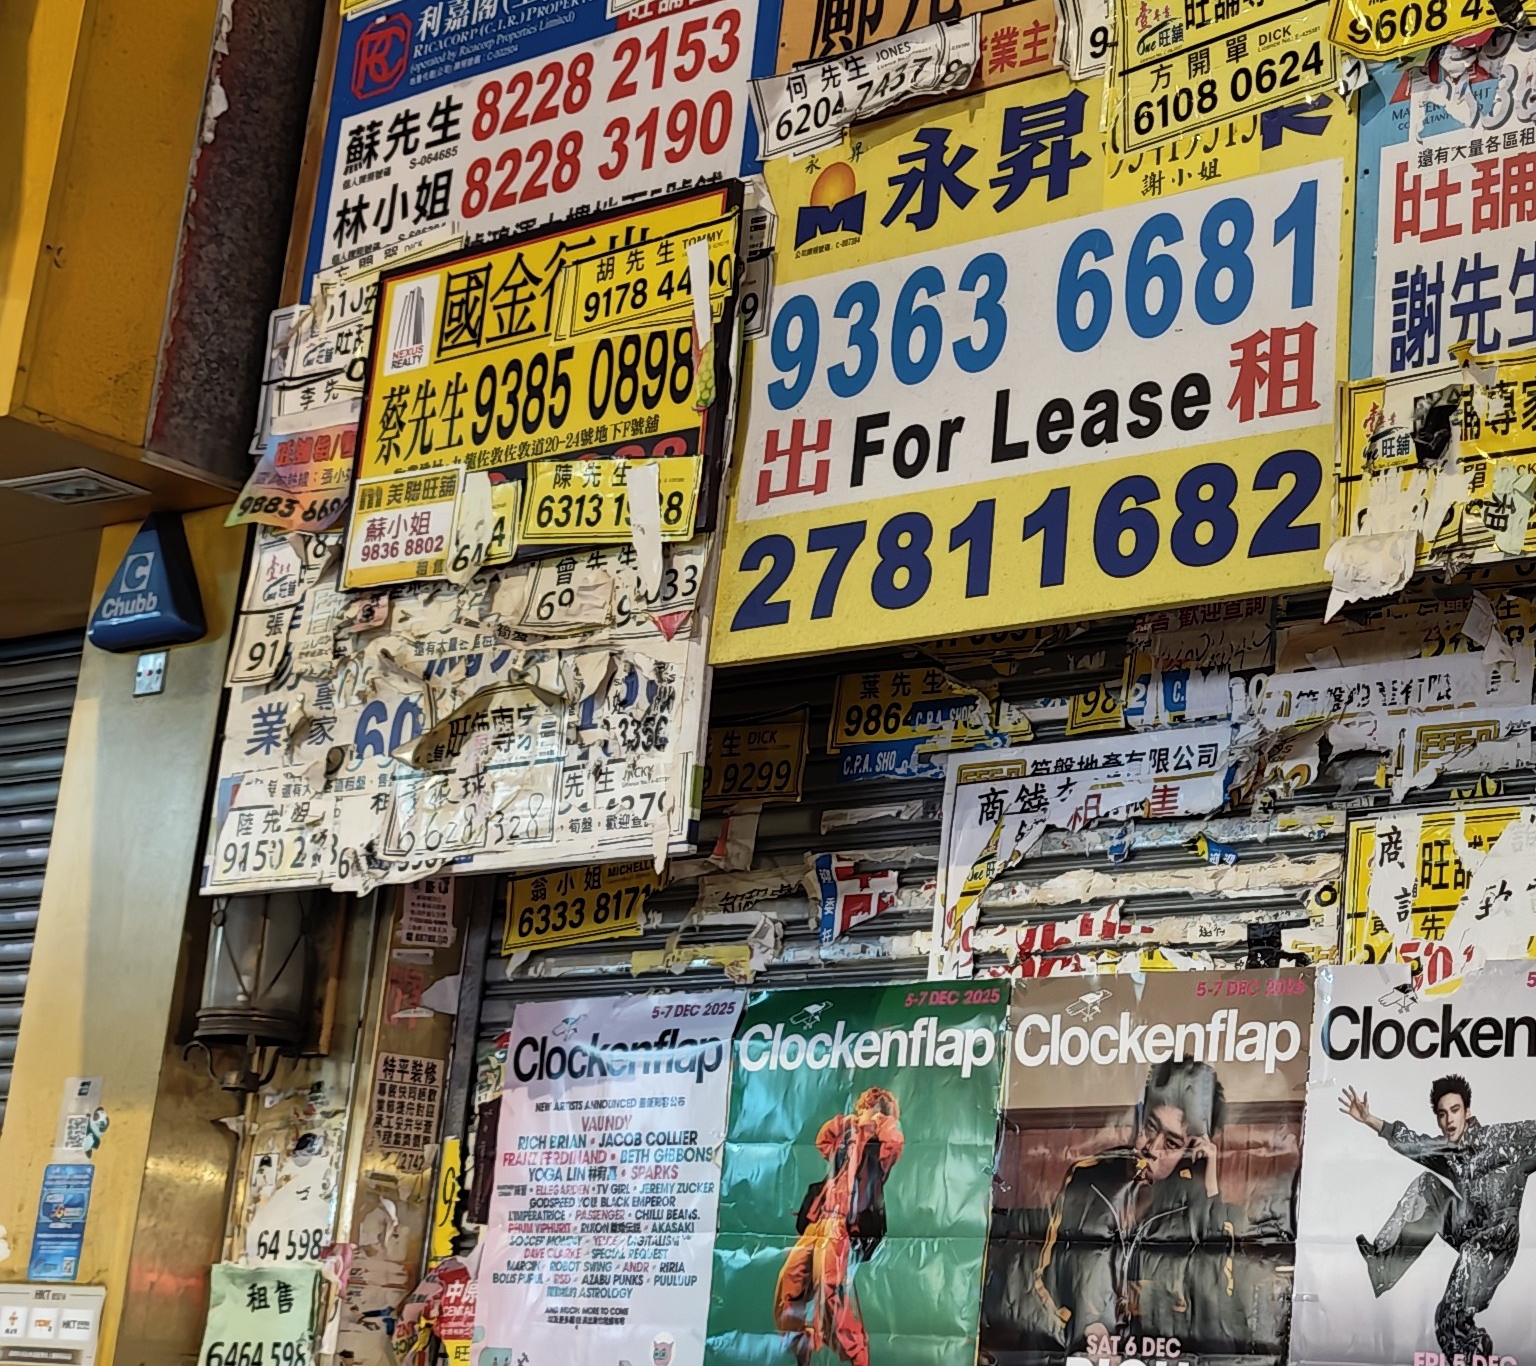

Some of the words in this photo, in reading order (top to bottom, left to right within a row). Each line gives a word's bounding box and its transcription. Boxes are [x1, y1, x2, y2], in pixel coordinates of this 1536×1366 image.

[344, 95, 463, 172] 蘇先生
[472, 52, 594, 142] 8228
[607, 8, 741, 103] 2153
[875, 42, 911, 63] JONES
[332, 168, 451, 248] 林小姐
[461, 130, 583, 219] 8228
[598, 91, 734, 182] 3190
[881, 87, 1092, 229] 永昇
[768, 251, 1009, 413] 9363
[1056, 177, 1320, 354] 6681
[391, 354, 422, 370] REALTY
[393, 346, 425, 361] NEXUS
[471, 352, 573, 436] 9385
[587, 324, 693, 419] 0898
[755, 419, 832, 506] 出
[850, 411, 964, 487] For
[992, 371, 1212, 461] Lease
[1228, 320, 1320, 423] 租
[730, 450, 1324, 634] 27811682
[101, 593, 158, 617] Chubb
[739, 1014, 994, 1077] Clockenflap
[247, 1281, 296, 1316] 租售
